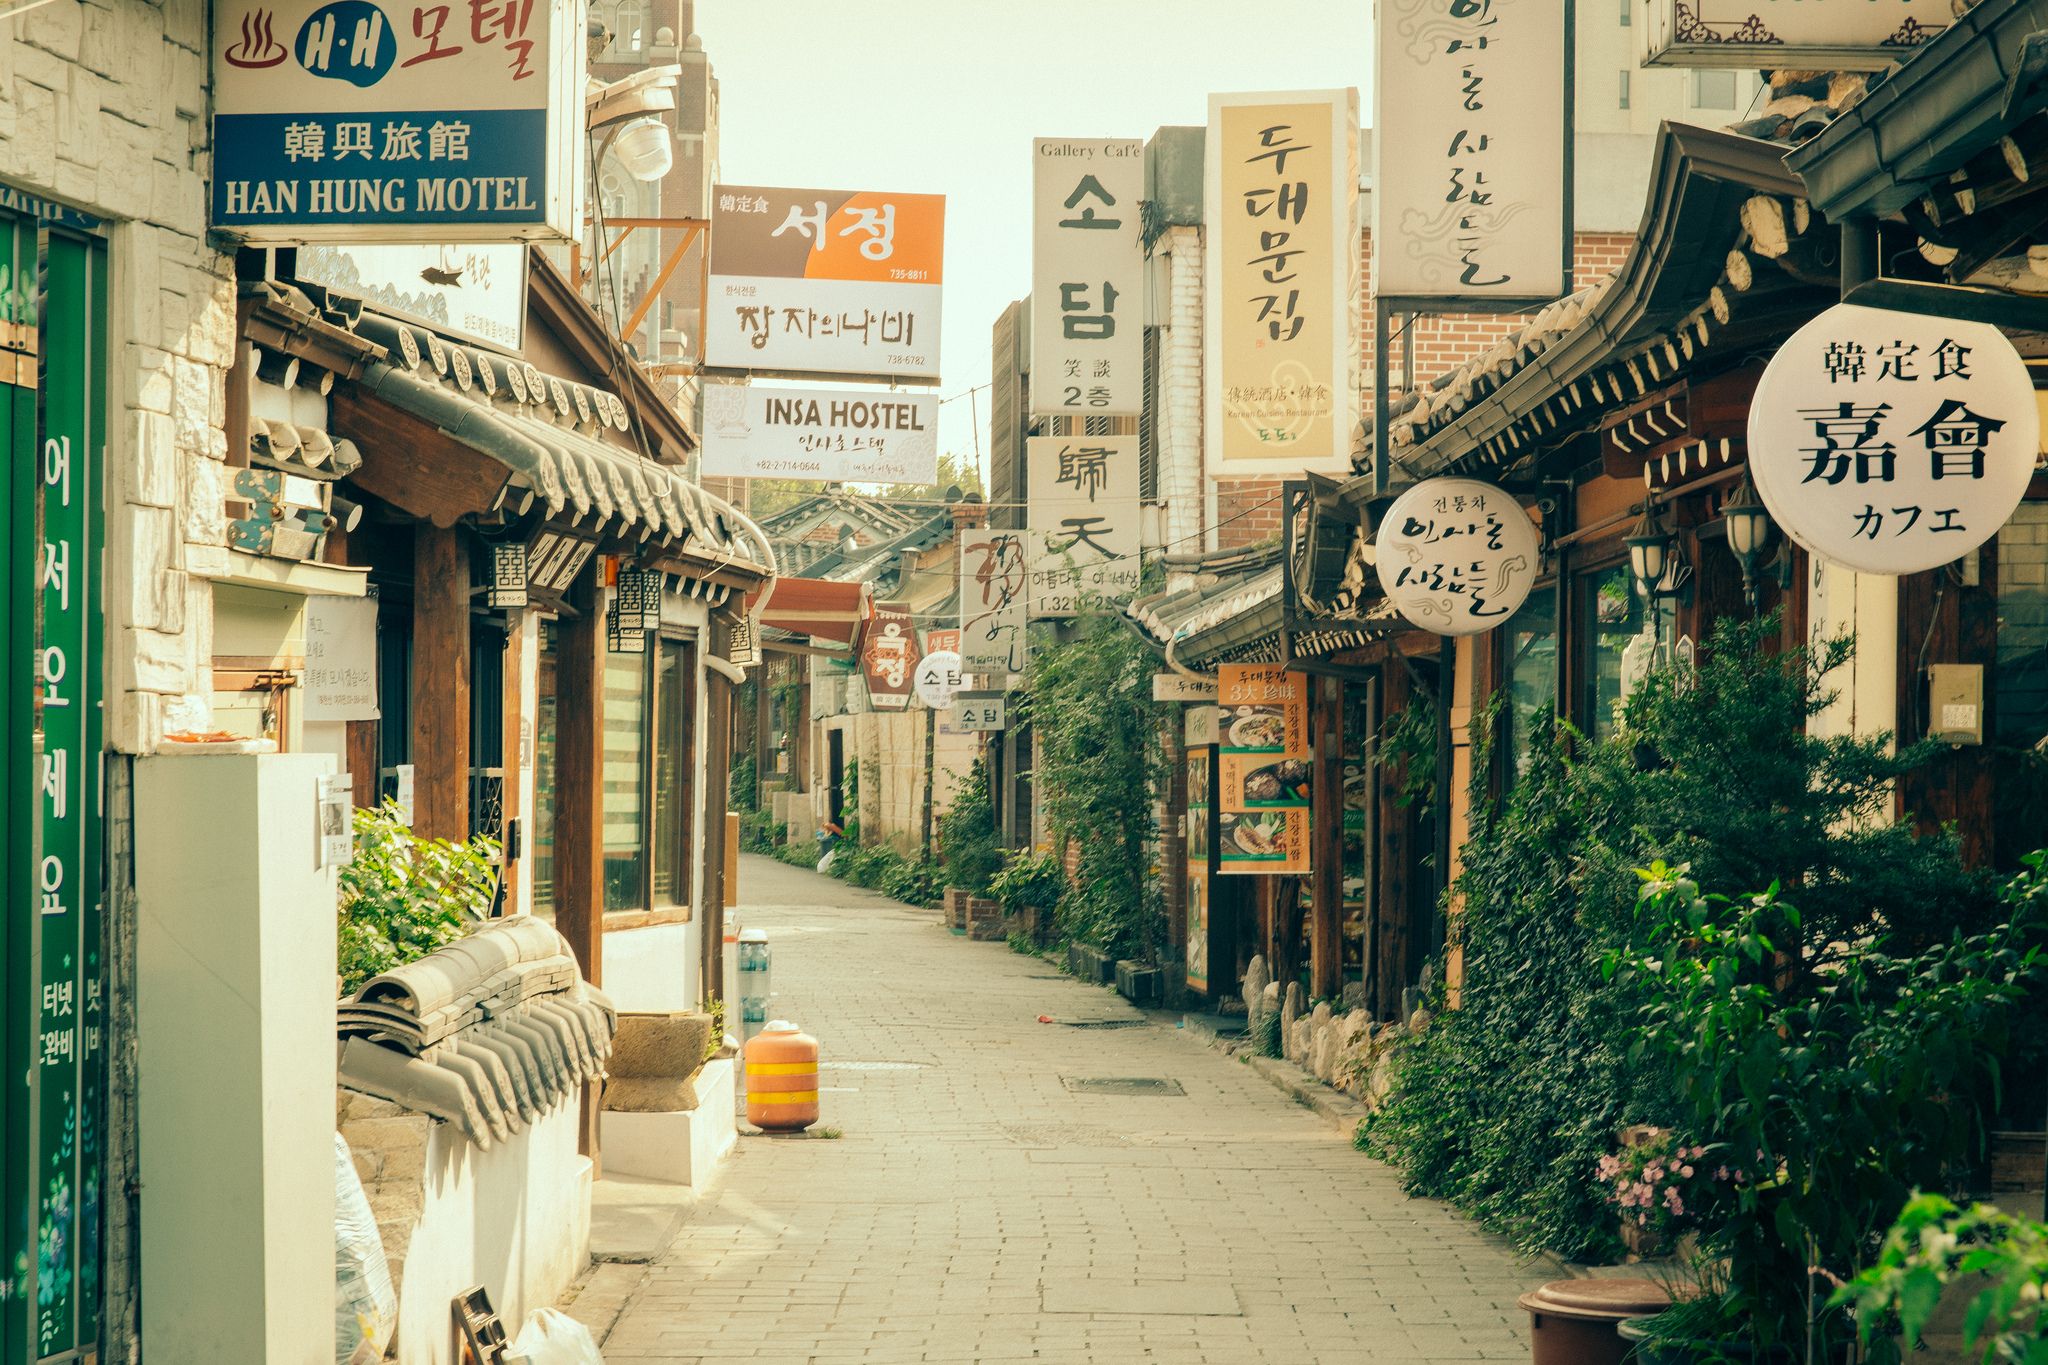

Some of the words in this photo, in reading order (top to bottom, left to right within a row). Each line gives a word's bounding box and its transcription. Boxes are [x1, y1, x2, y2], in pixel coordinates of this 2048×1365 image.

[401, 0, 534, 81] 모텔
[285, 120, 471, 163] 韓興旅館
[1041, 143, 1096, 160] Gallery
[225, 180, 299, 214] HAN
[309, 178, 405, 214] HUNG
[417, 177, 537, 212] MOTEL
[720, 194, 769, 213] 韓定食
[771, 201, 896, 261] 서정
[1243, 125, 1313, 341] 두대문집
[1822, 338, 1973, 383] 韓定食
[1063, 386, 1112, 407] 2층
[765, 398, 822, 427] INSA
[830, 401, 924, 431] HOSTEL
[1227, 409, 1254, 418] Korean
[1257, 409, 1285, 418] Cuisine
[1286, 408, 1328, 417] Restaurant
[799, 434, 885, 456] 인사호스텔
[1796, 398, 2008, 485] 嘉會
[1432, 495, 1486, 513] 전통차
[1032, 569, 1081, 590] 아름다
[1176, 680, 1218, 692] 두대문
[1239, 671, 1287, 684] 두대문집
[40, 980, 73, 1018] 터넷
